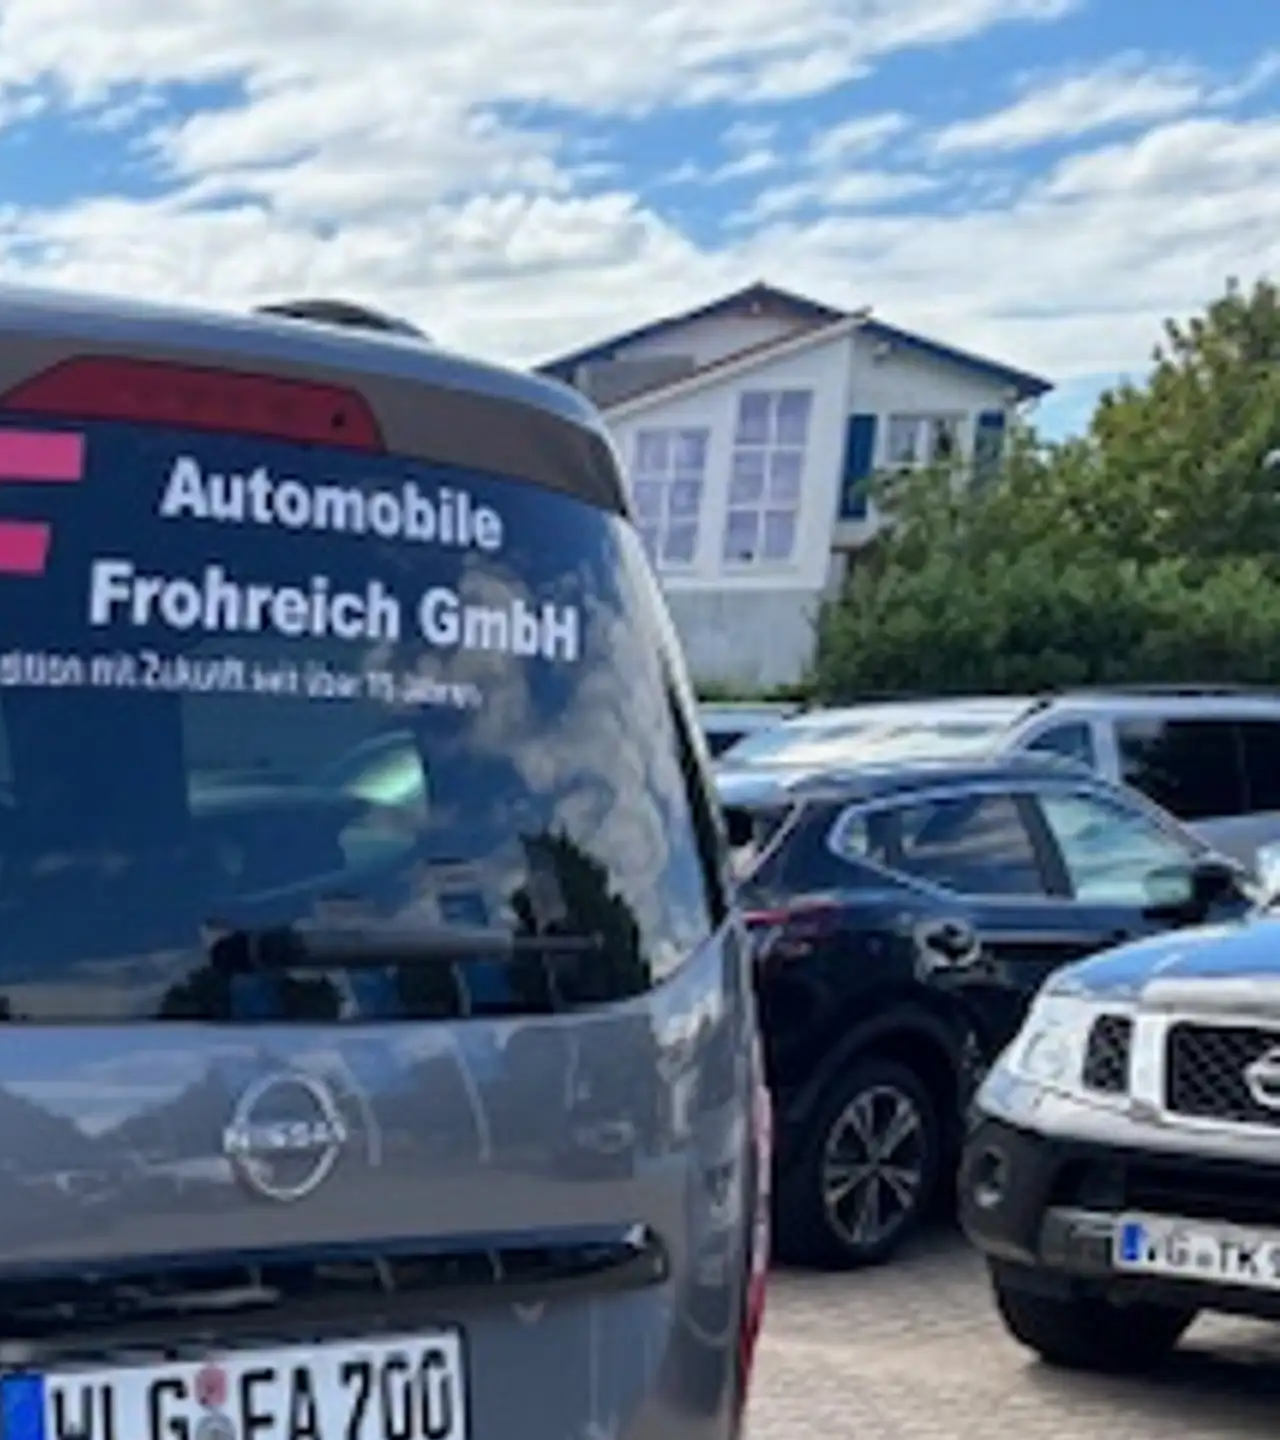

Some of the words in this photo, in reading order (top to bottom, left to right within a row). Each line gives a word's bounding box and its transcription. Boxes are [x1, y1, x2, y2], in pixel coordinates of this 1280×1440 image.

[161, 457, 506, 550] Automobile
[89, 561, 402, 641] Frohreich
[420, 588, 581, 661] GmbH
